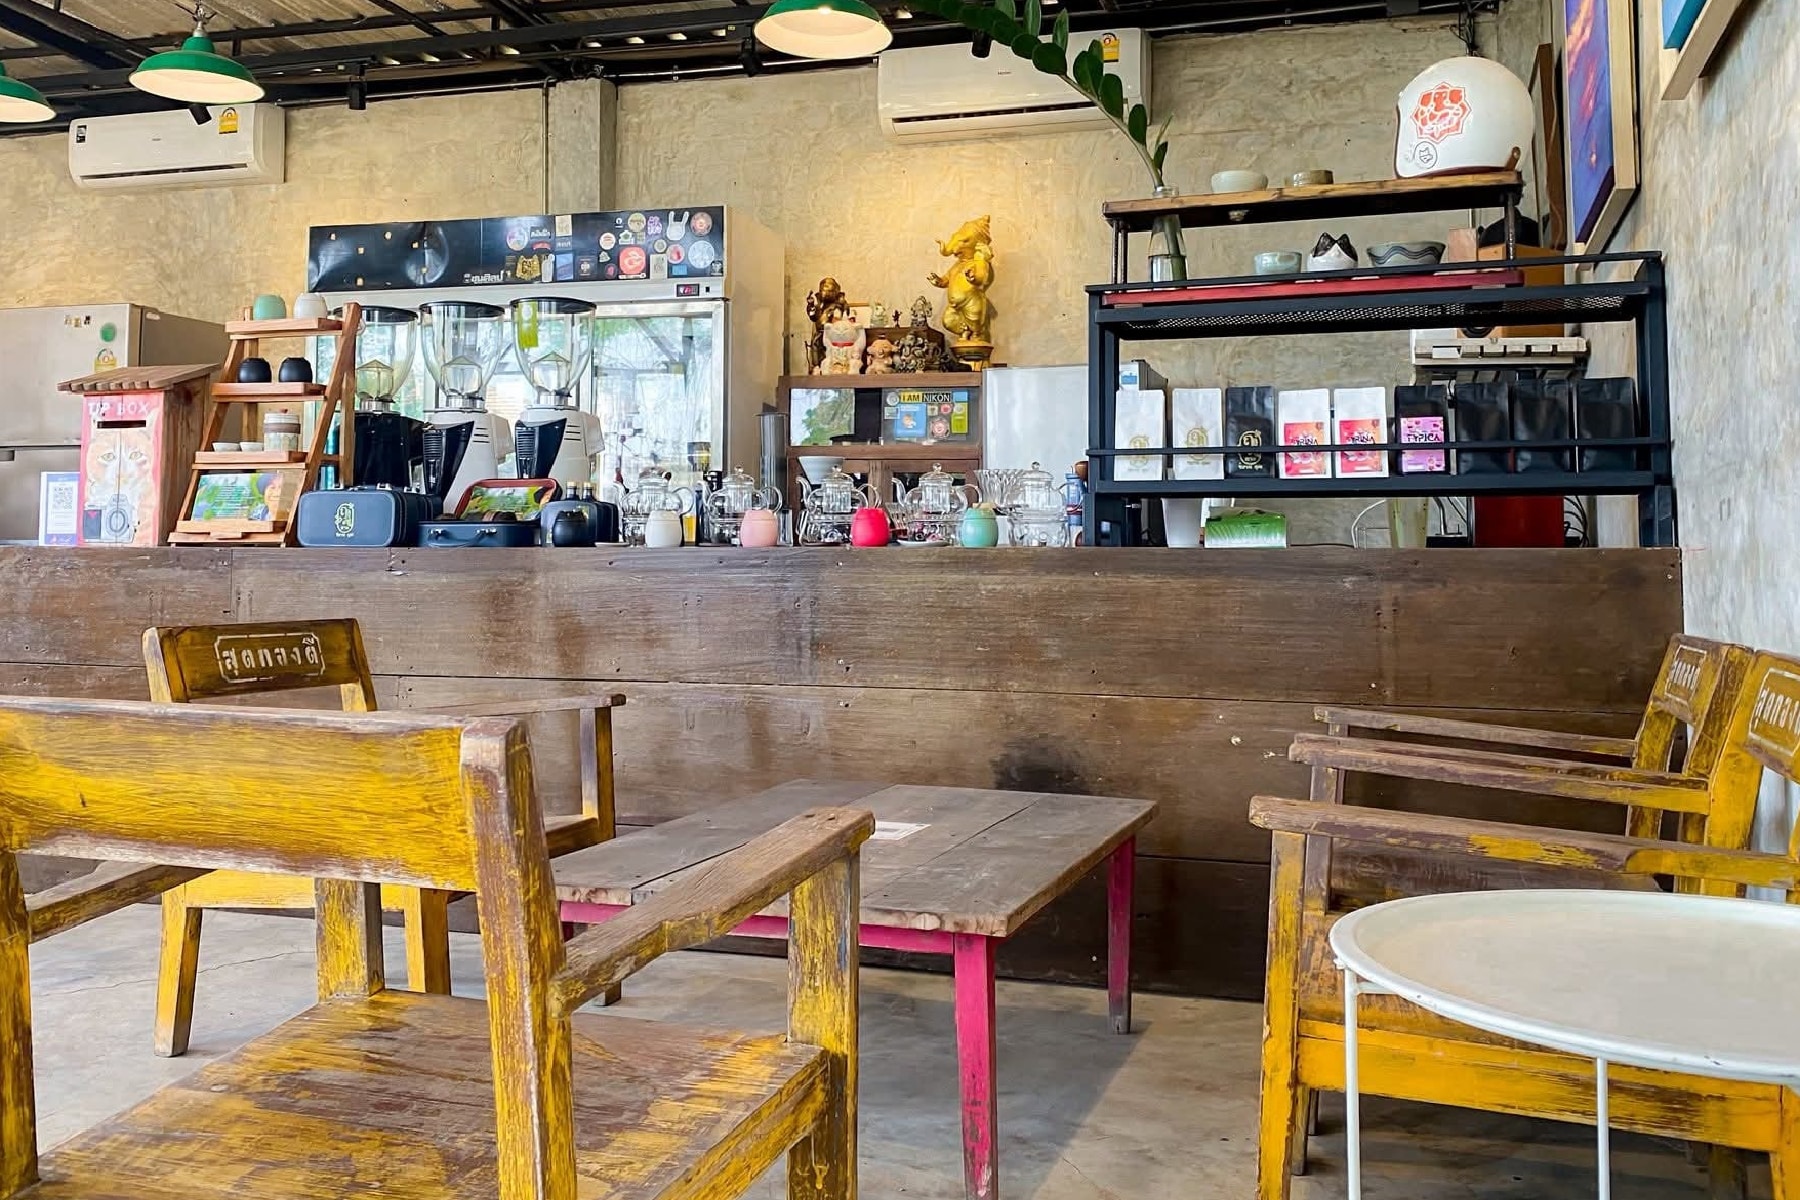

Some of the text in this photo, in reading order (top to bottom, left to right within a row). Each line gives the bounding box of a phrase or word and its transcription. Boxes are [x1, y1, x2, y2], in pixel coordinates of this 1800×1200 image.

[907, 394, 920, 402] AM
[923, 394, 950, 402] NIKON
[88, 401, 149, 416] TIP BOX
[1407, 432, 1441, 442] TYPICA
